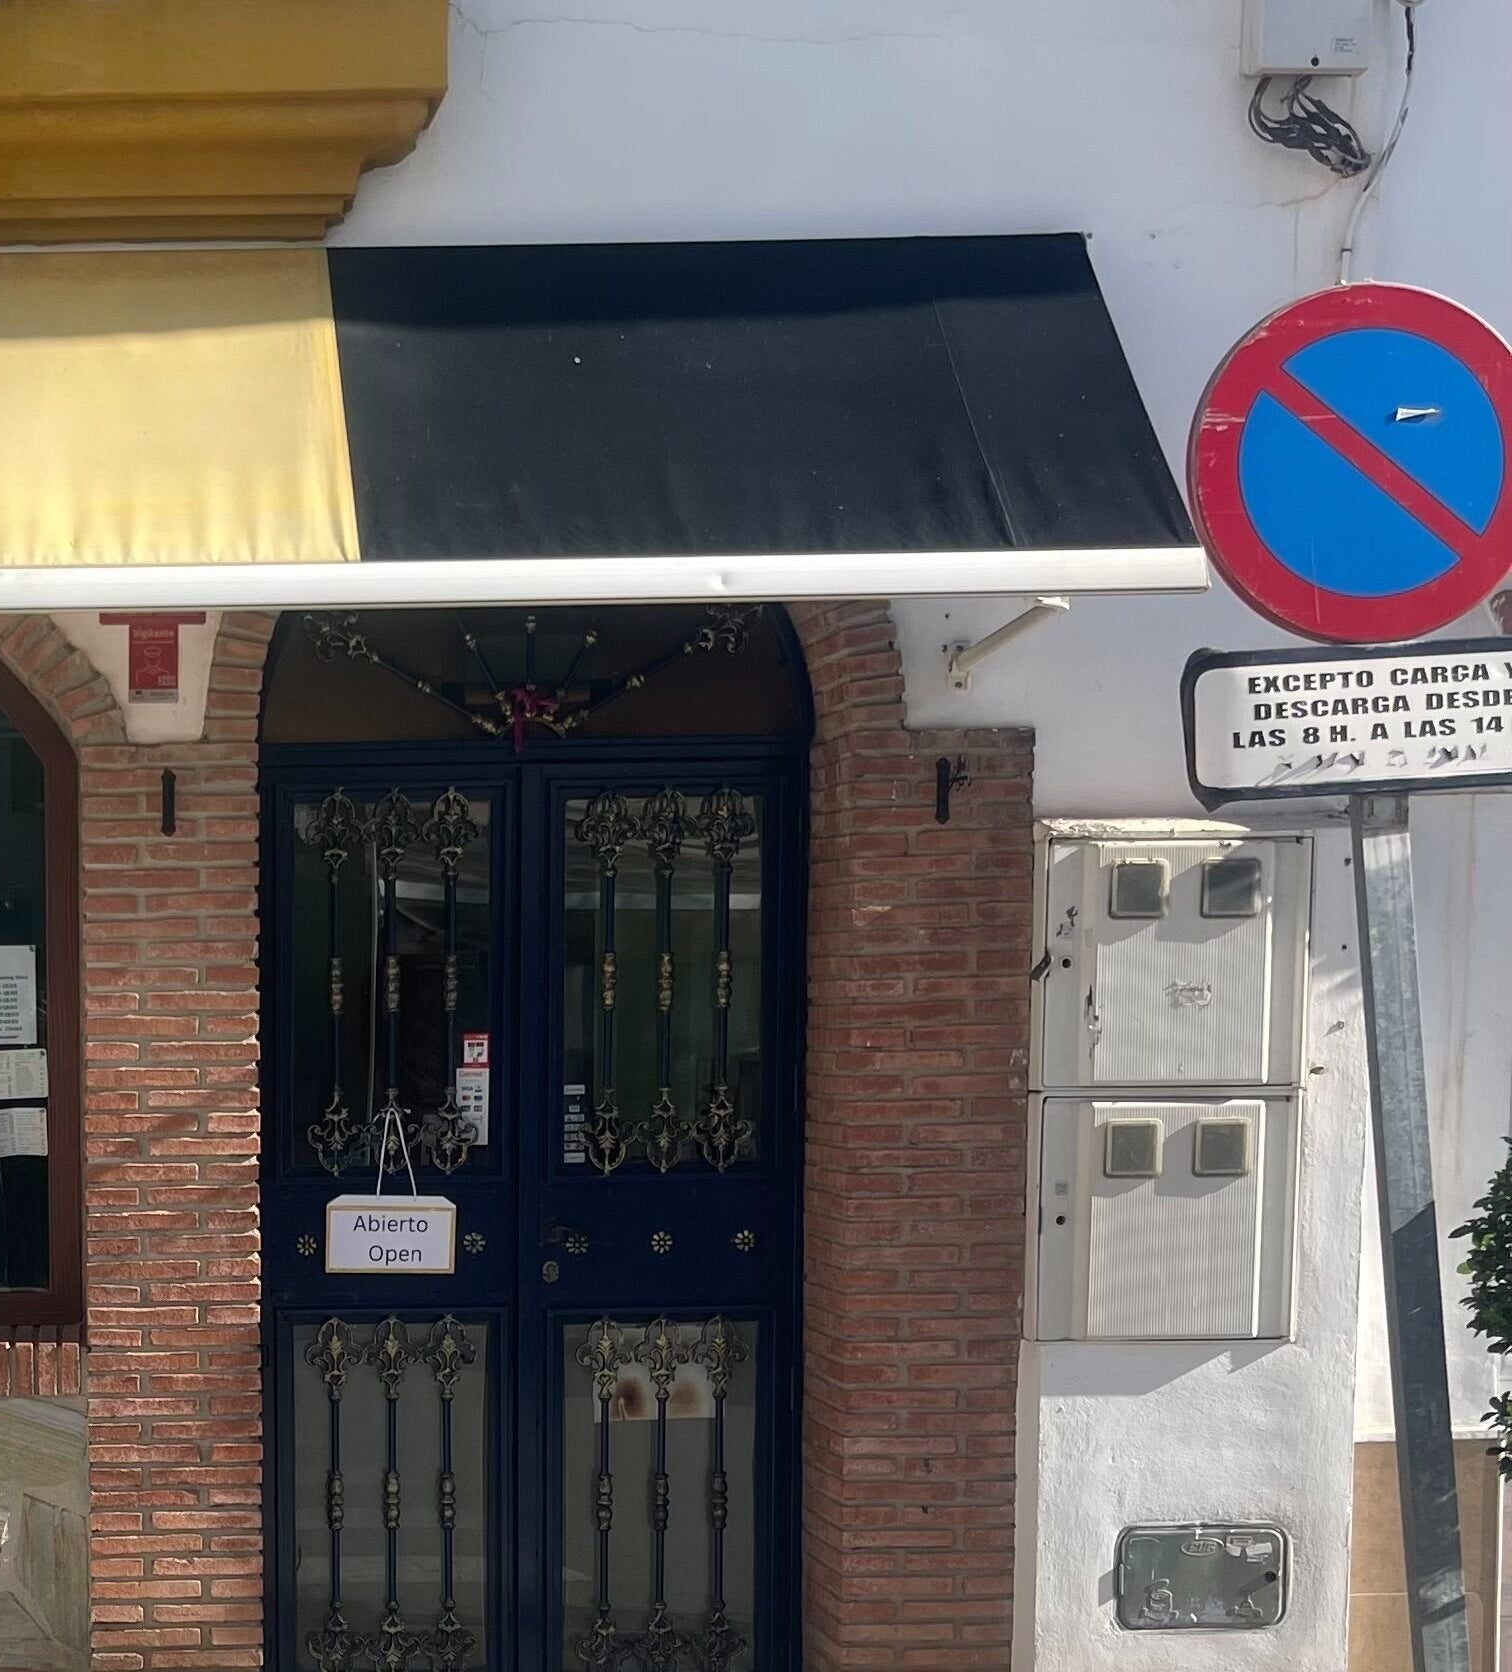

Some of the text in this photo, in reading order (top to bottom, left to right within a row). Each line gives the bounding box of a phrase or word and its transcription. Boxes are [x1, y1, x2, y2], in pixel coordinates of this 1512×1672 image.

[133, 629, 175, 640] Vigilante
[1248, 670, 1374, 694] EXCEPTO
[1390, 663, 1489, 687] CARGA
[1253, 689, 1512, 721] DESCARGA DESDE
[1233, 716, 1504, 749] LAS 8 H. A LAS 14
[353, 1215, 428, 1233] Abierto
[369, 1245, 422, 1266] Open
